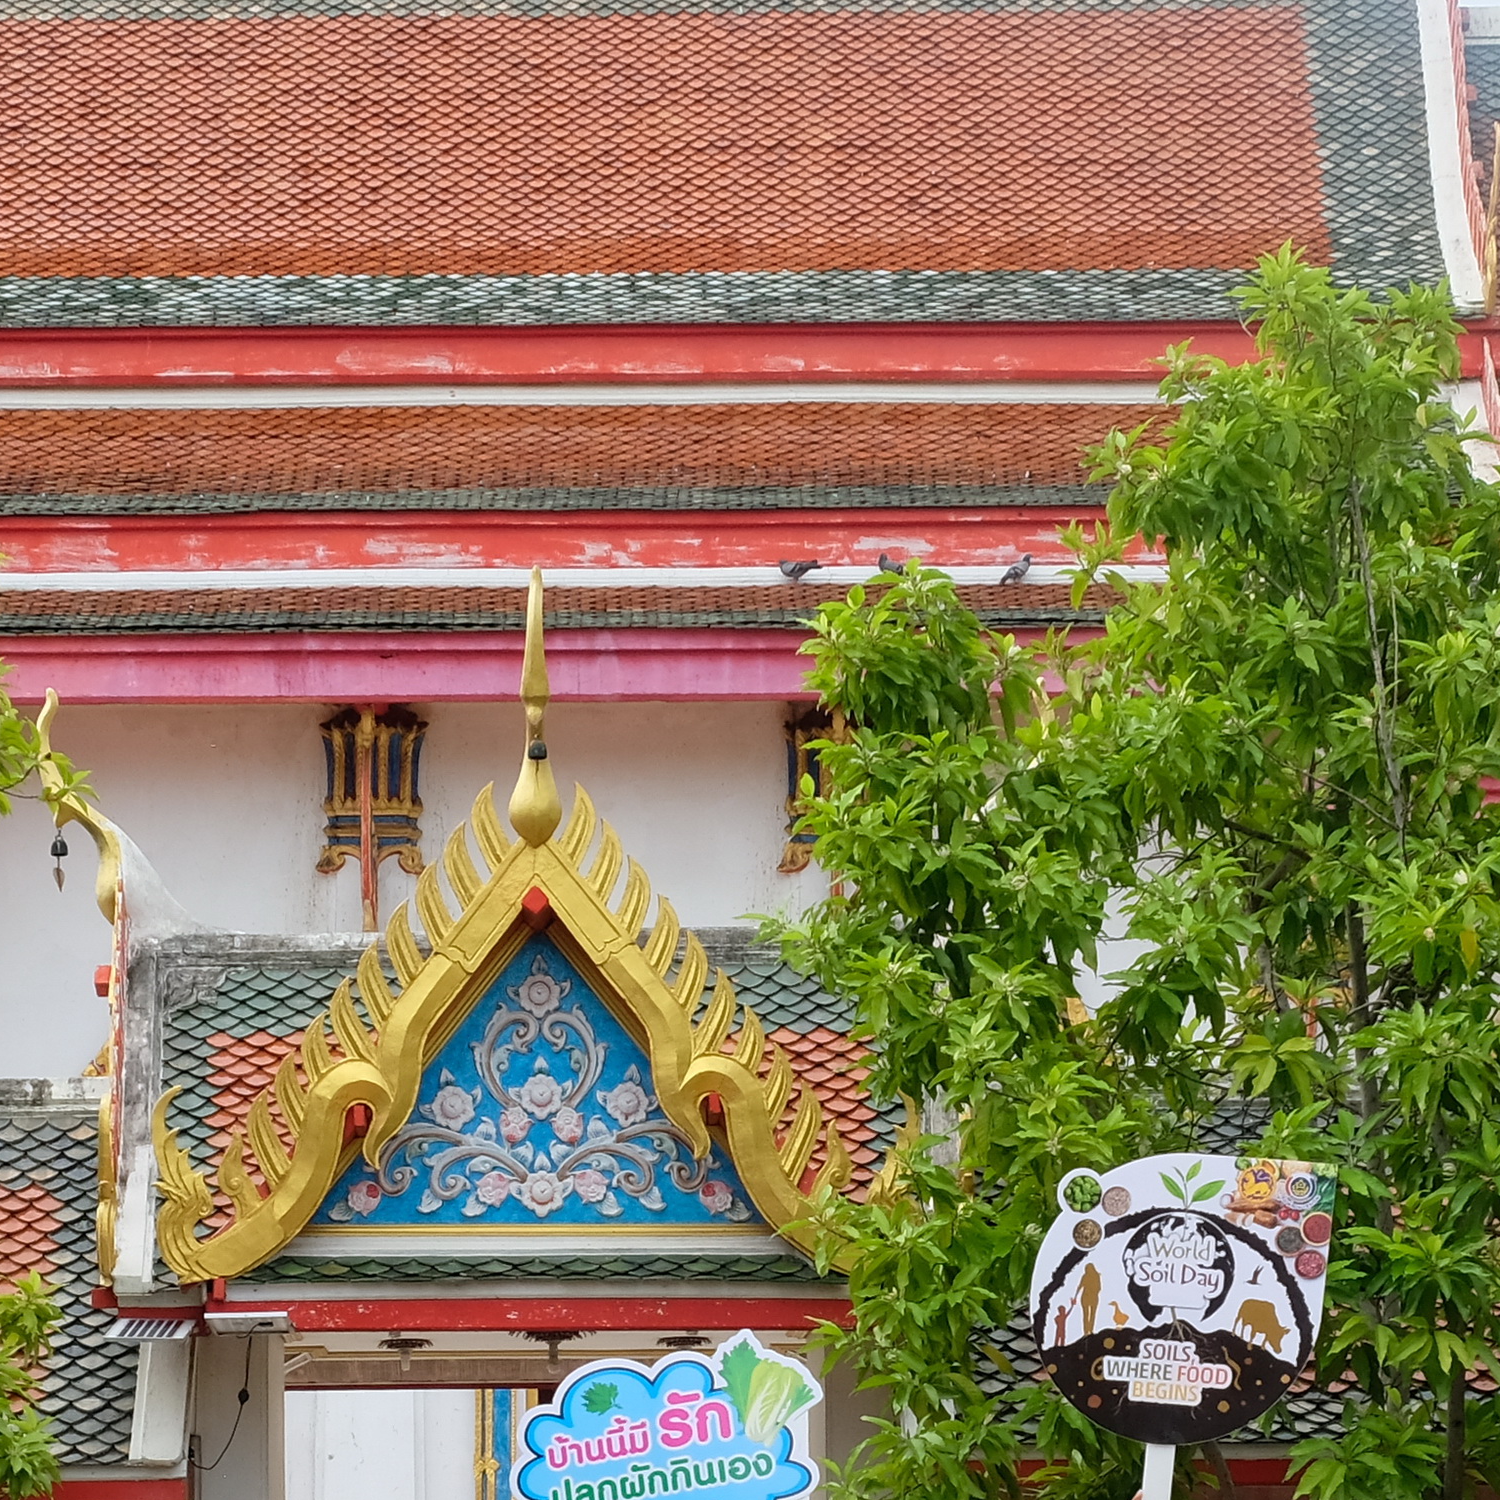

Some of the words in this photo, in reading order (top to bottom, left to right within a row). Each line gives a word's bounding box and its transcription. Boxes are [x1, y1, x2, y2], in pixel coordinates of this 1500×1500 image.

[1151, 1237, 1213, 1262] World
[1138, 1260, 1176, 1285] Soil
[1180, 1263, 1221, 1294] Day
[1142, 1342, 1196, 1365] SOILS,
[1107, 1360, 1173, 1381] WHERE
[1177, 1365, 1229, 1385] FOOD
[1132, 1381, 1198, 1402] BEGINS
[547, 1417, 650, 1469] บ้านนี้มี
[658, 1392, 732, 1448] รัก
